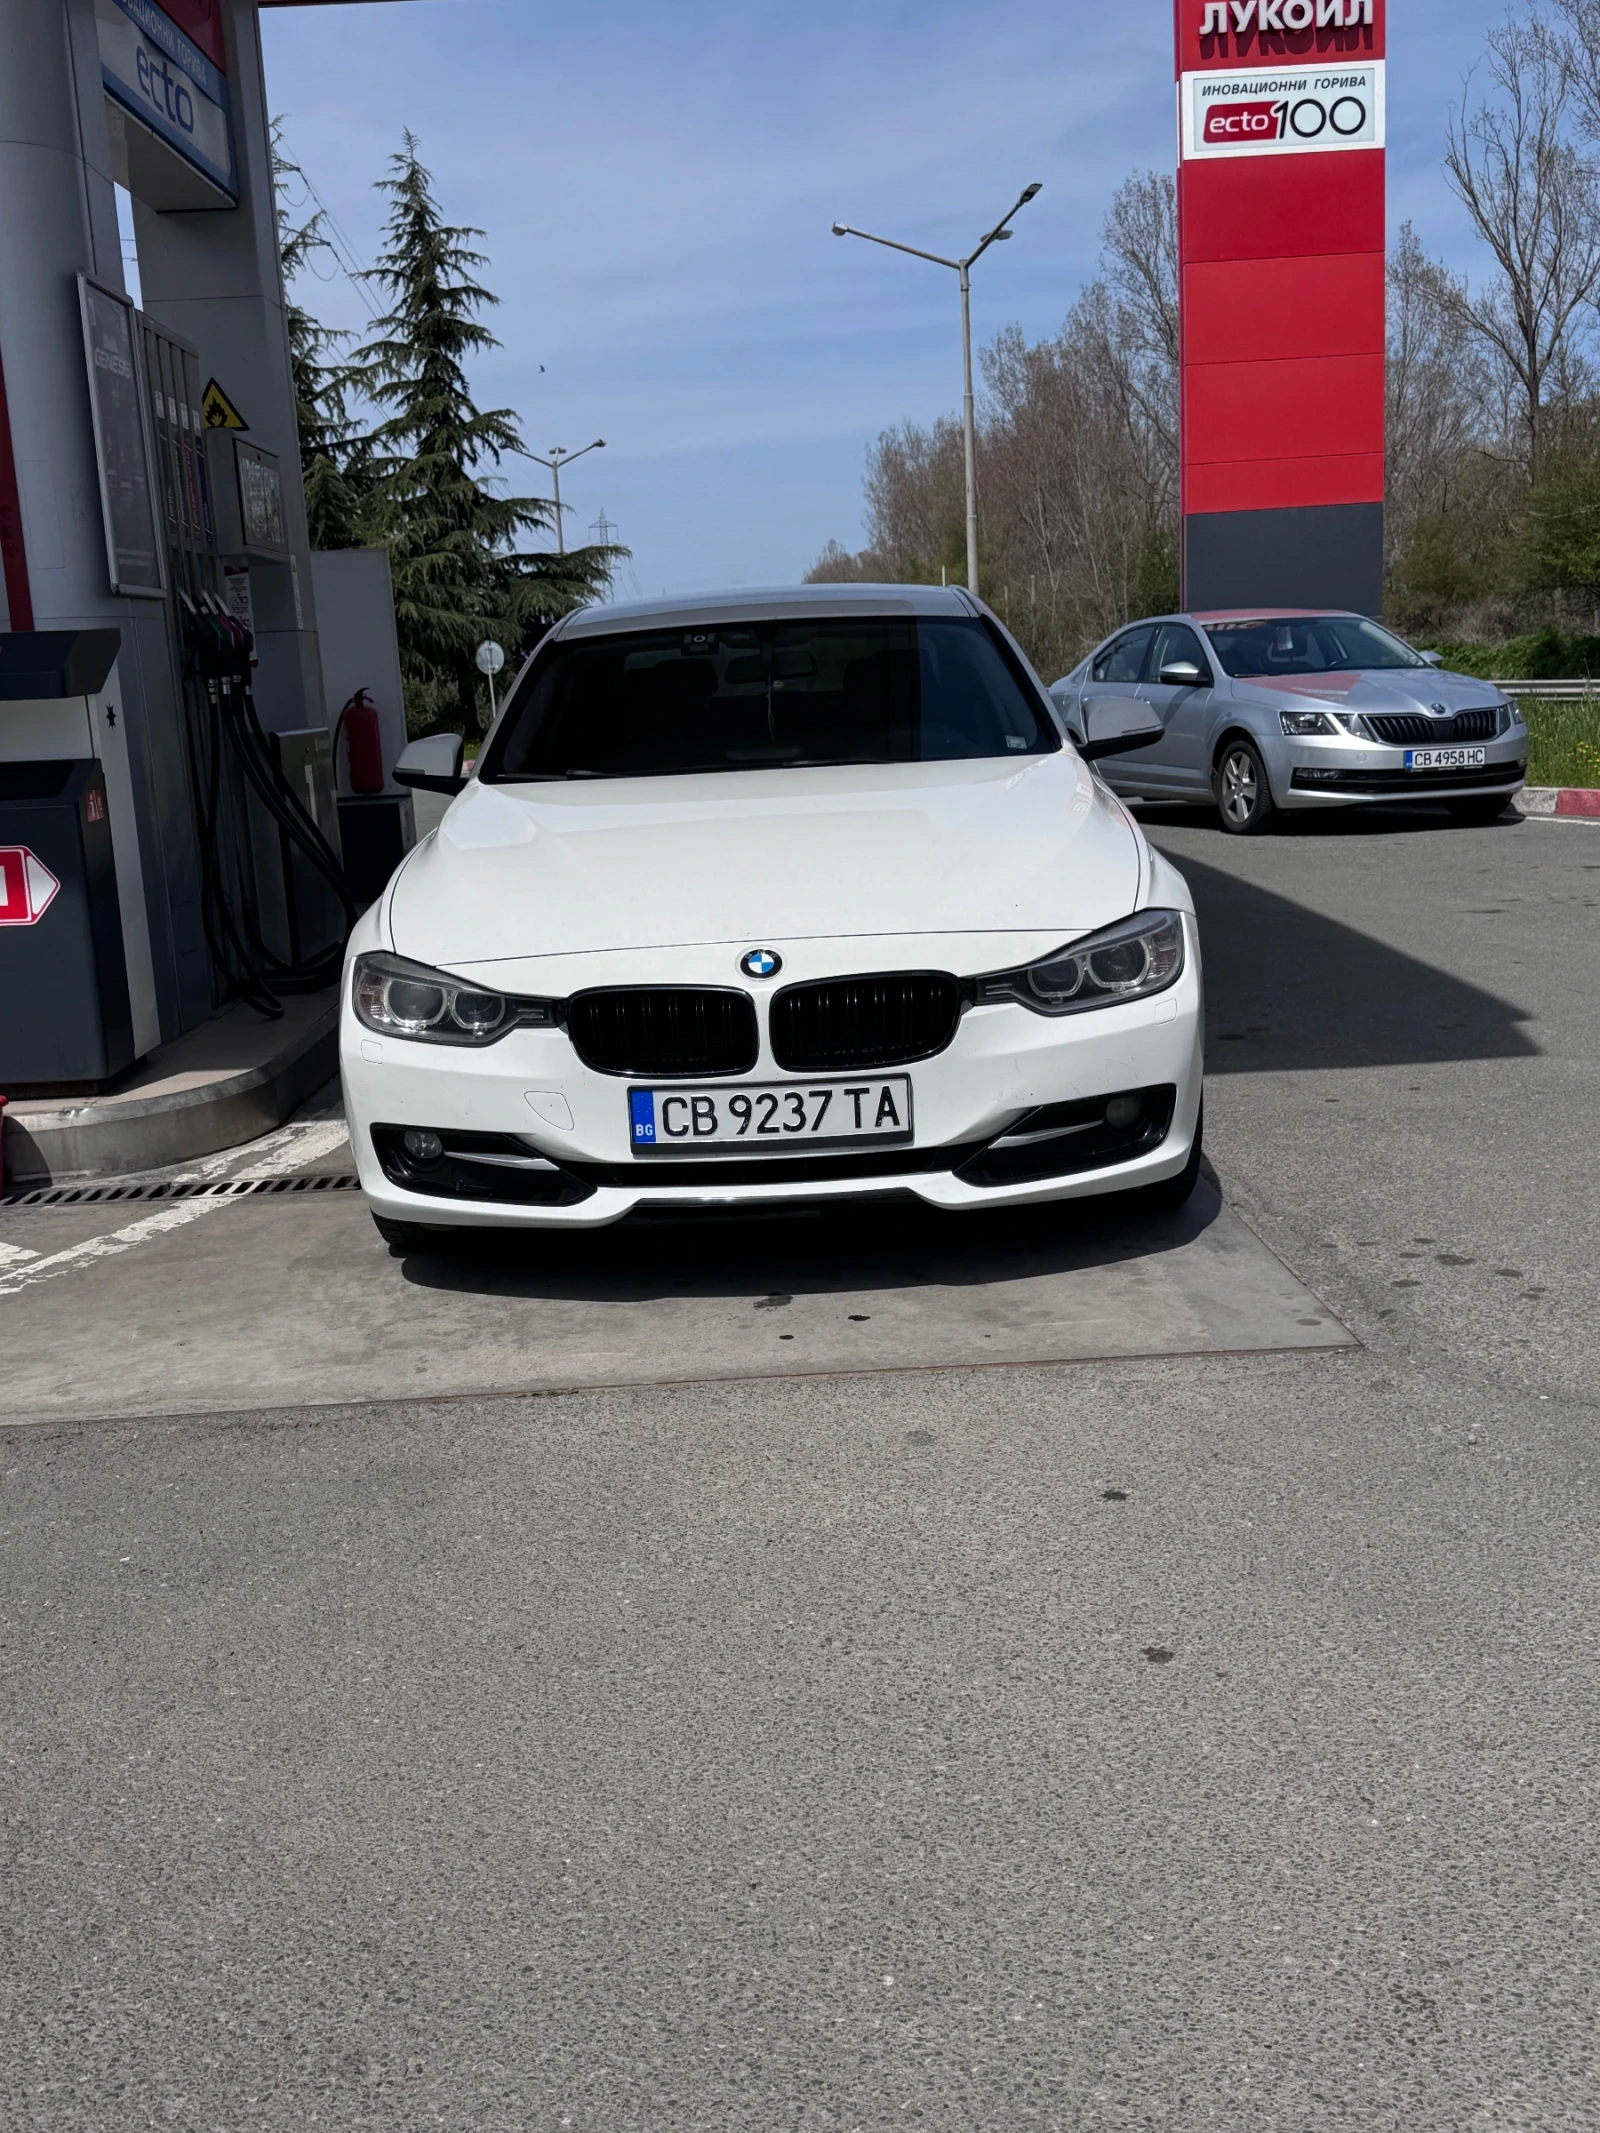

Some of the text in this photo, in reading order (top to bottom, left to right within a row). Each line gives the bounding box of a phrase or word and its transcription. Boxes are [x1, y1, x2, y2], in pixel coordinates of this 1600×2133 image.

[136, 45, 194, 134] ecto
[1201, 75, 1367, 97] ИНОВАЦИОННИ ГОРИВА
[1434, 750, 1465, 765] 4958
[662, 1085, 901, 1137] CB 9237 TA
[635, 1123, 653, 1136] BG
